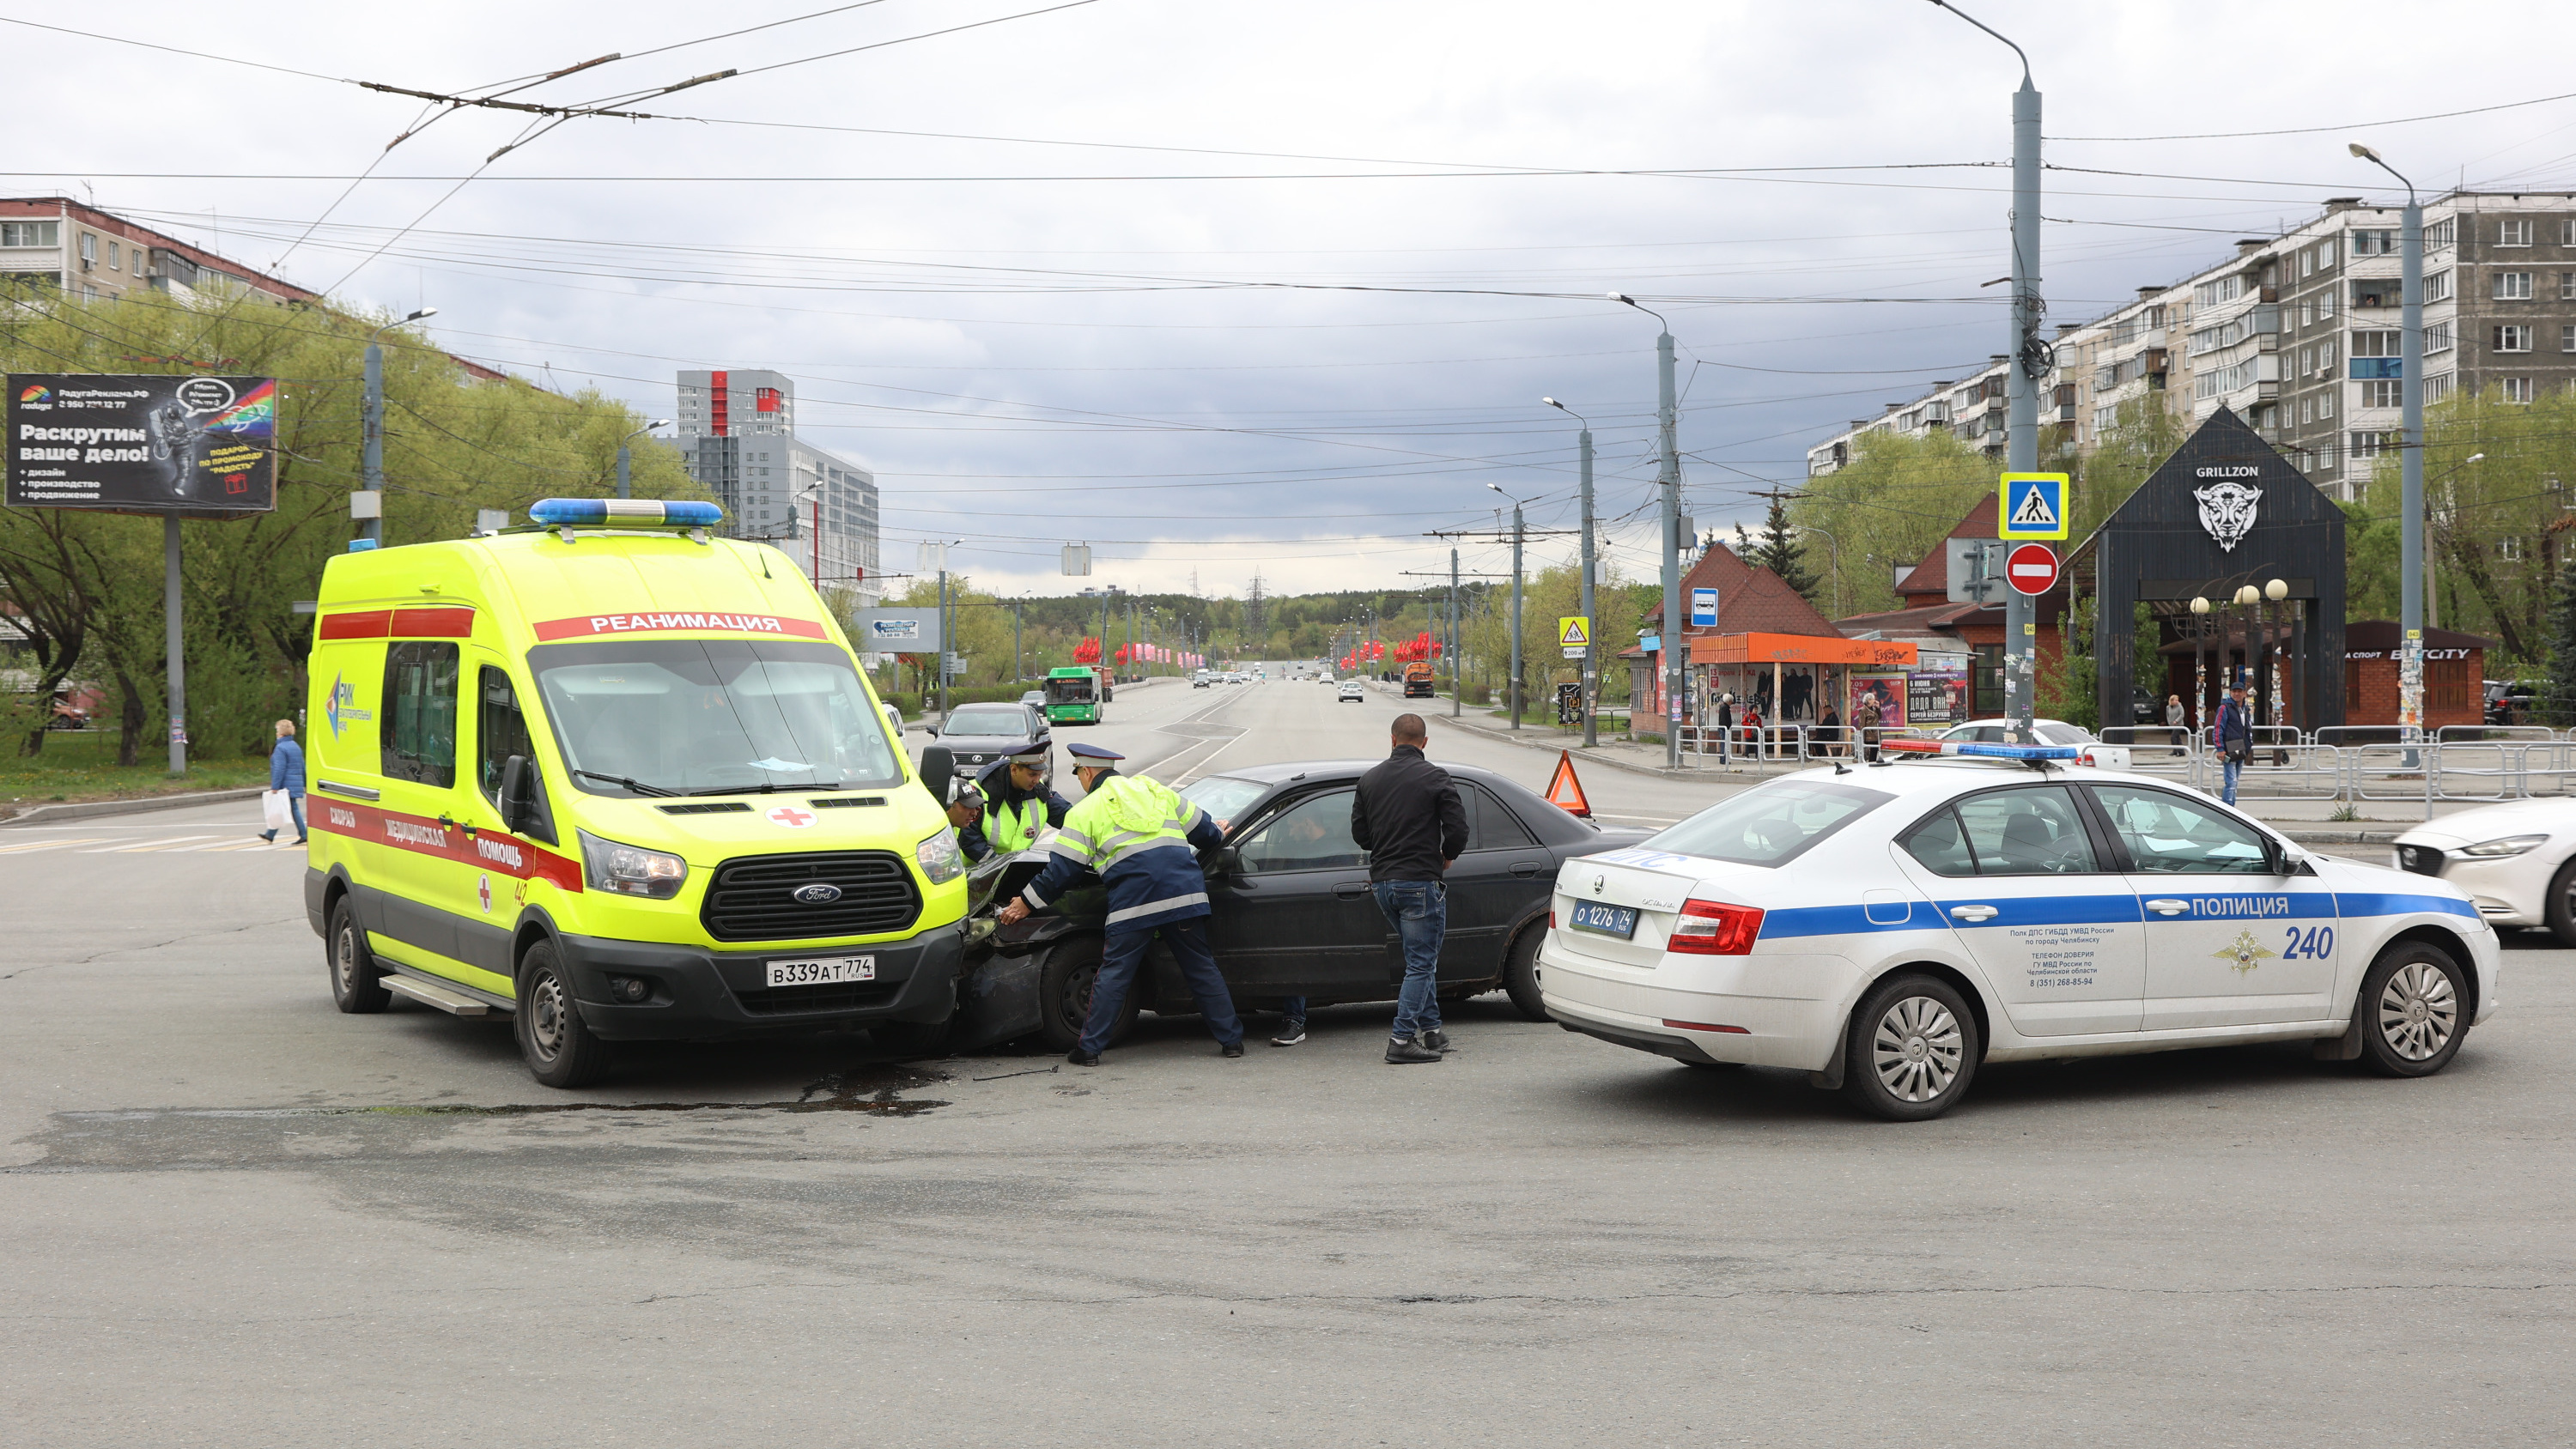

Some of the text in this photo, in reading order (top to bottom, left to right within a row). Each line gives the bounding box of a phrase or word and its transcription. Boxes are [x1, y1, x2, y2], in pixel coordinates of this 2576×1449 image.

[20, 424, 147, 445] Раскрутим
[20, 446, 149, 464] ваше дело!
[27, 468, 67, 477] дизайн
[2196, 466, 2259, 477] GRILLZON
[27, 480, 102, 489] производство
[27, 491, 101, 500] продвижение
[590, 614, 782, 633] РЕАНИМАЦИЯ
[329, 806, 523, 870] СКОРАЯ МЕДИЦИНСКАЯ ПОМОЩЬ
[514, 881, 528, 906] 442
[805, 888, 832, 900] Ford
[1641, 898, 1675, 909] OCTAVIA
[2192, 897, 2289, 919] ПОЛИЦИЯ
[1589, 906, 1614, 928] 1276
[1619, 909, 1631, 925] 74
[2028, 929, 2044, 937] ДПС
[2044, 928, 2069, 937] ГИБДД
[2282, 926, 2334, 961] 240
[774, 959, 871, 984] В339АТ 774
[2030, 978, 2093, 989] 8 (351) 268-85-94
